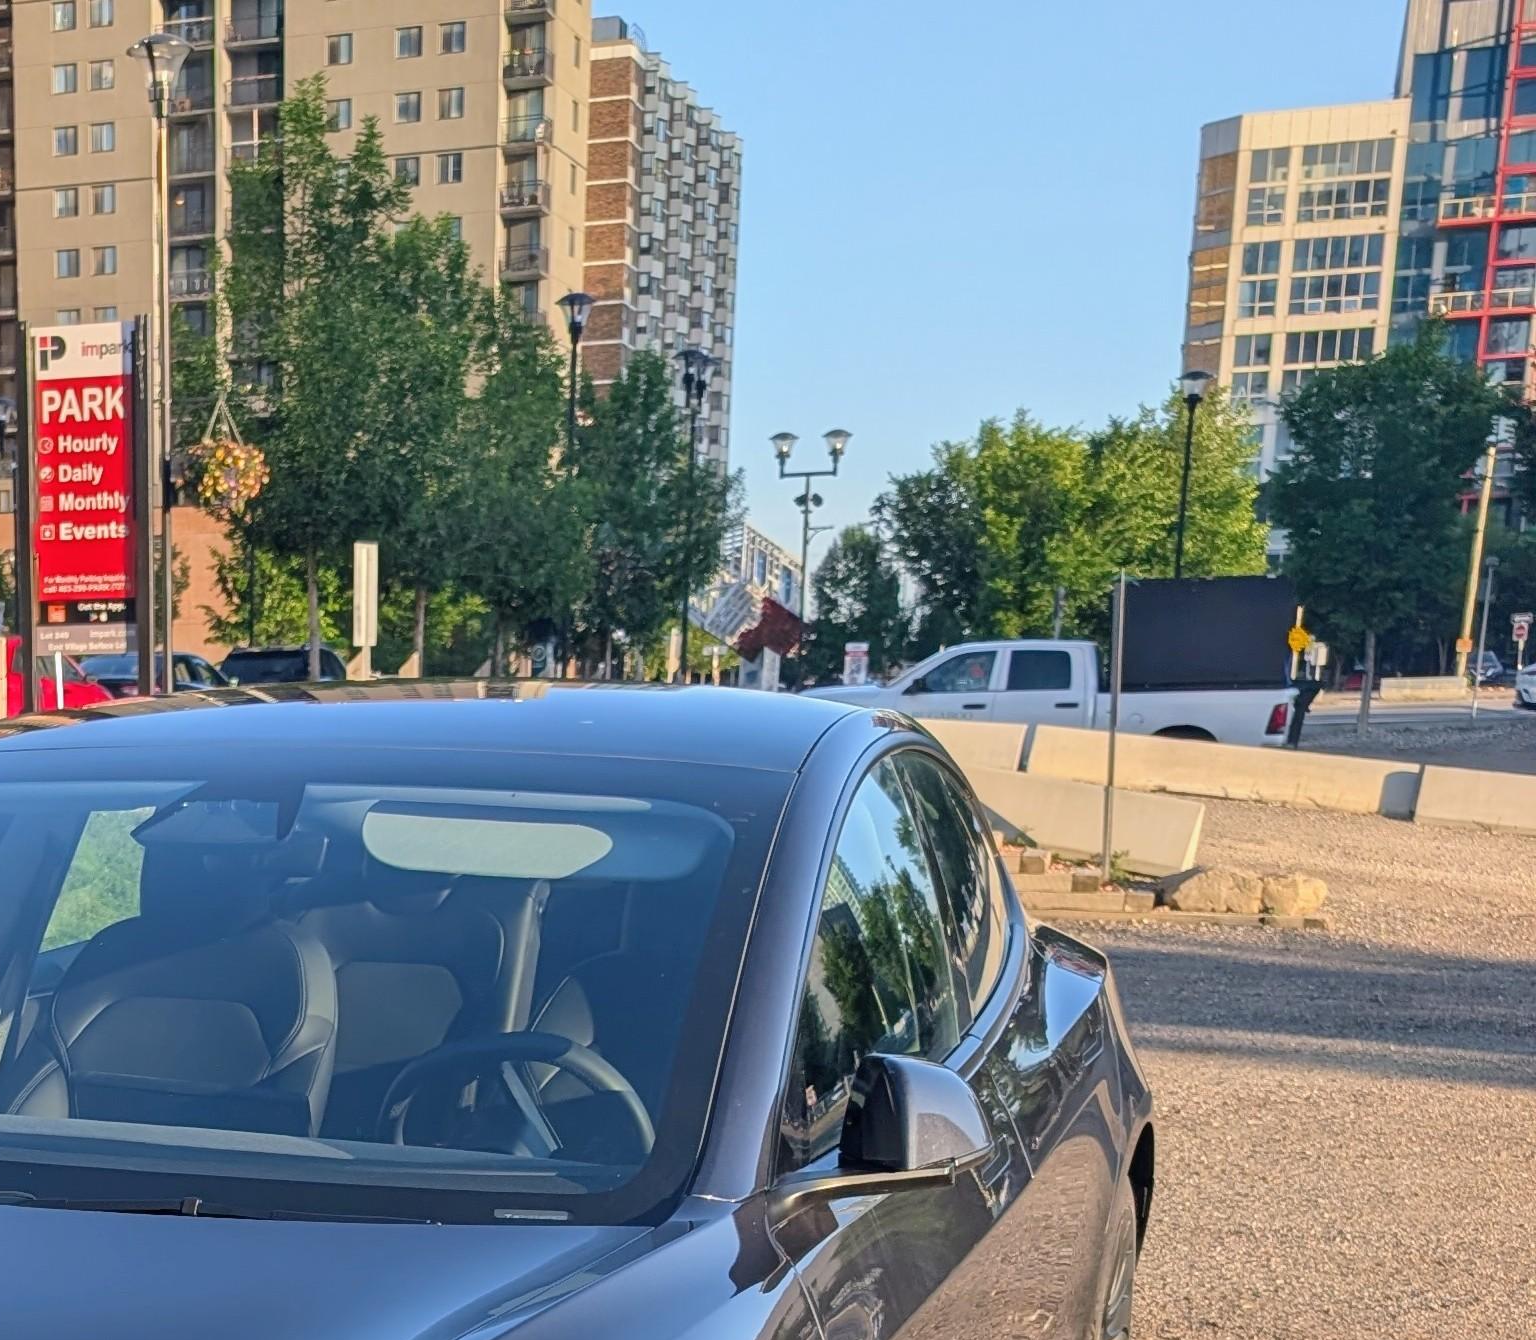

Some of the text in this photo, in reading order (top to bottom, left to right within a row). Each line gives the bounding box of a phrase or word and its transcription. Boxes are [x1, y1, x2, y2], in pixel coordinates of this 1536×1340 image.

[81, 341, 132, 359] impark
[41, 386, 124, 424] PARK
[57, 432, 118, 455] Hourly
[58, 462, 103, 485] Daily
[58, 491, 130, 513] Monthly
[58, 521, 130, 540] Events
